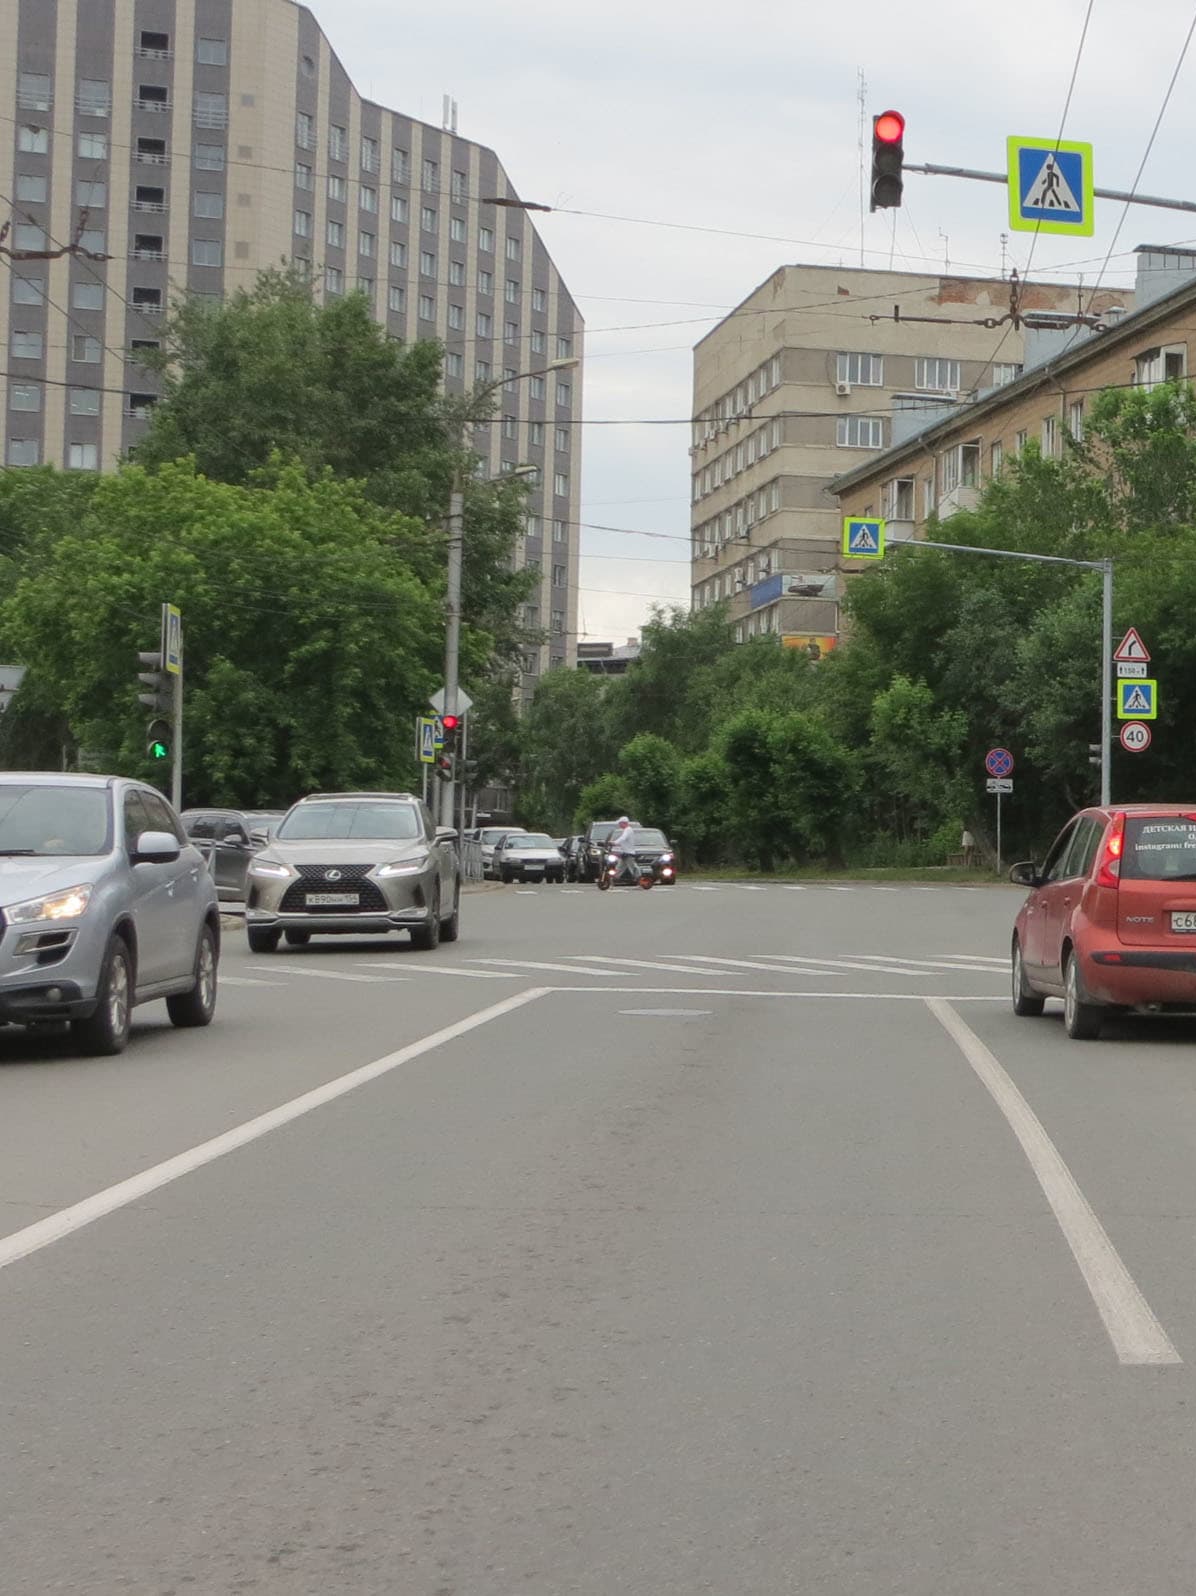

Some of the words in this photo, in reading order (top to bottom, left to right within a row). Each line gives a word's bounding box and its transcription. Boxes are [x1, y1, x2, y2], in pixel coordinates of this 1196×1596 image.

[1126, 730, 1144, 743] 40
[1142, 824, 1186, 834] ДЕТСКАЯ
[1188, 824, 1196, 832] И
